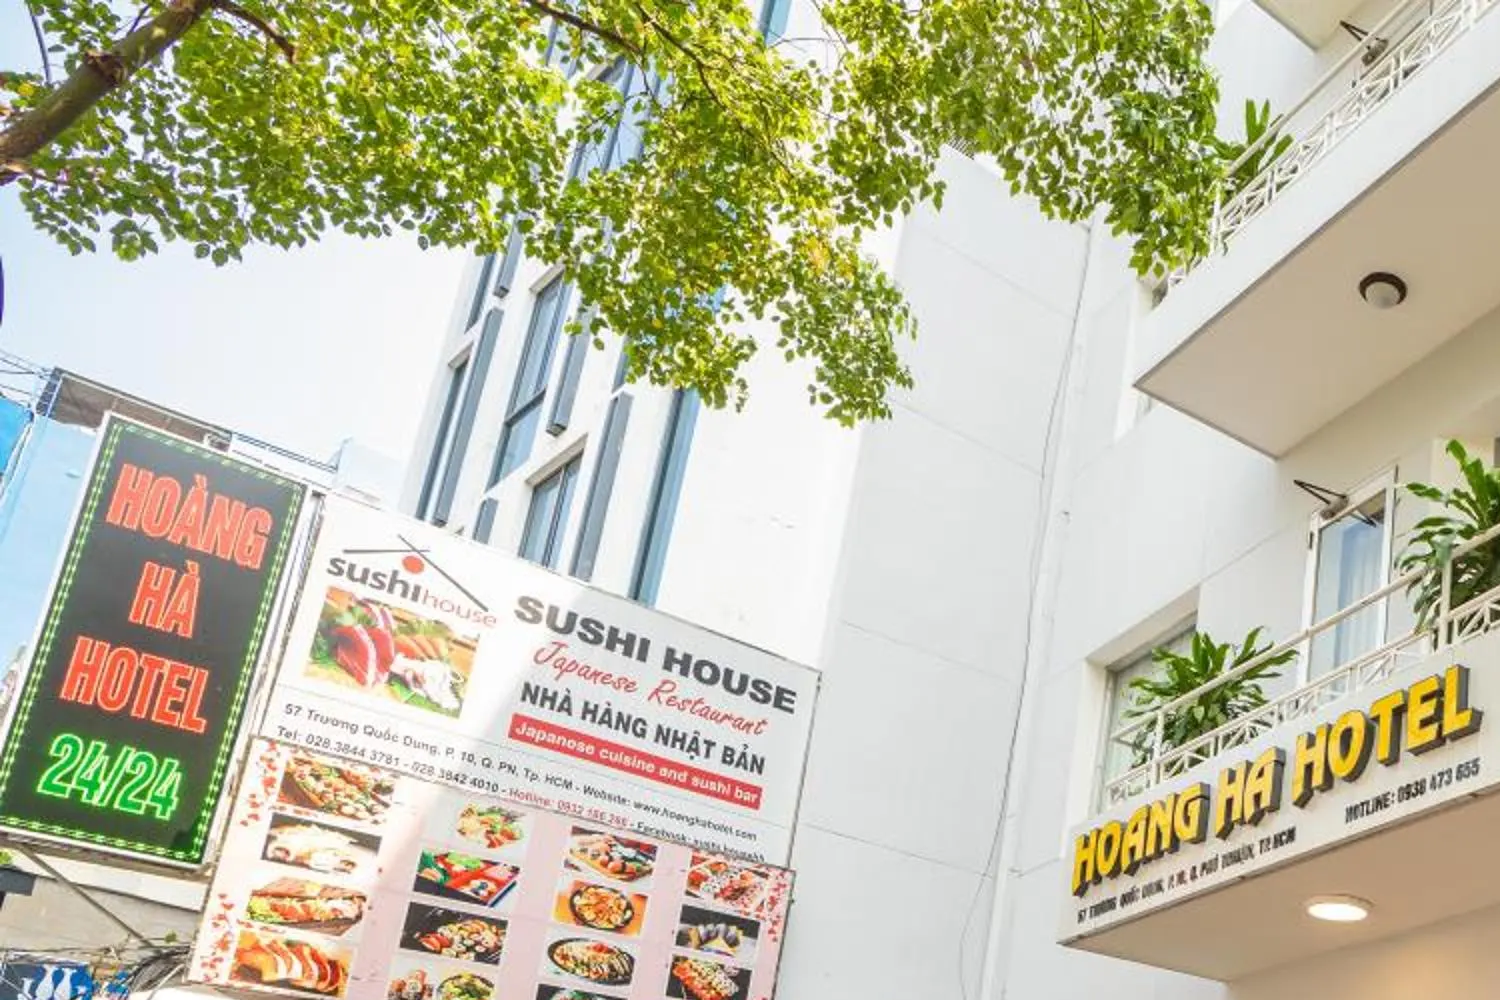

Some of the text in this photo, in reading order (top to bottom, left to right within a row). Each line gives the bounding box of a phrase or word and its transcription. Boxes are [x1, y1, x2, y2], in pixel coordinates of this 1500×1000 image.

[106, 463, 274, 570] HOÀNG
[128, 559, 200, 638] HÀ
[60, 636, 209, 734] HOTEL
[514, 595, 797, 714] SUSHI HOUSE
[533, 640, 768, 735] Japanese Restaurant
[284, 703, 302, 717] 57
[545, 773, 573, 789] HCM
[515, 721, 759, 803] Japanese cuisine and sushi bar
[521, 681, 765, 776] NHÀ HÀNG NHẬT BẢN
[37, 733, 185, 821] 24/24
[1072, 663, 1484, 897] HOANG HA HOTEL
